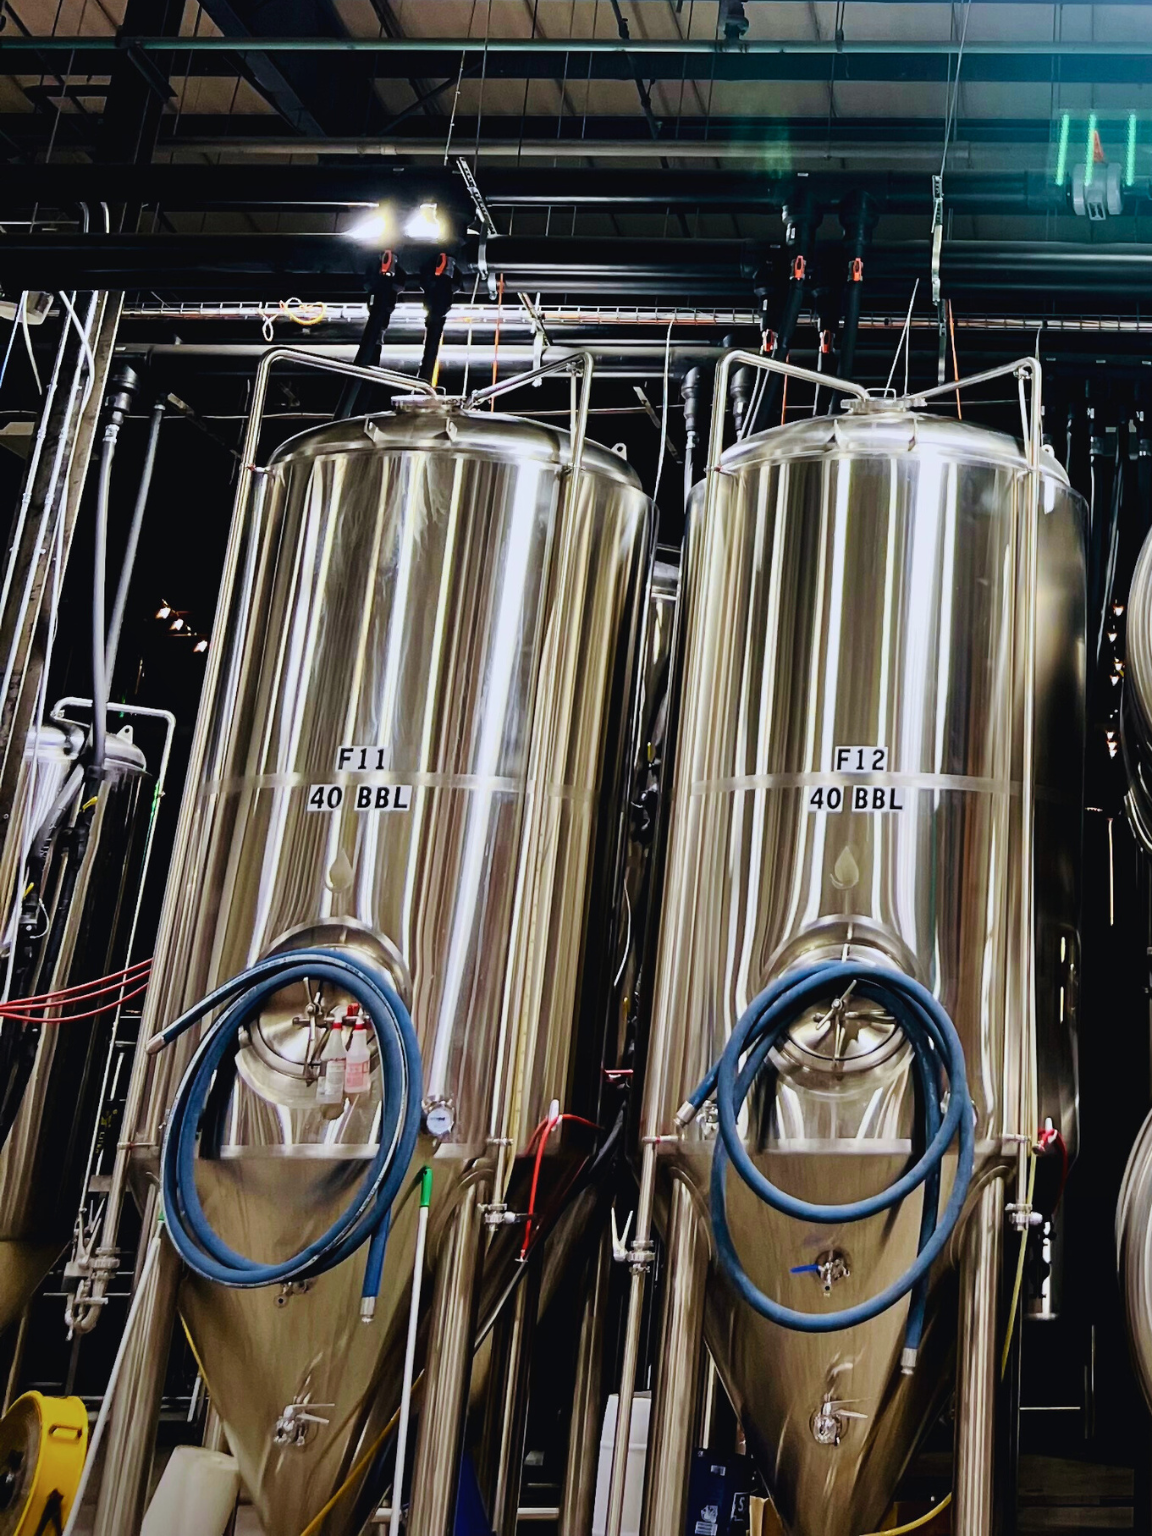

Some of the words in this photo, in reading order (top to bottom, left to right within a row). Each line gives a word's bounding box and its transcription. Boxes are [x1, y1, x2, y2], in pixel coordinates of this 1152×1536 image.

[338, 748, 384, 770] F11
[837, 748, 885, 770] F12
[310, 786, 343, 809] 40
[357, 786, 408, 808] BBL
[810, 787, 841, 809] 40
[855, 787, 903, 810] BBL
